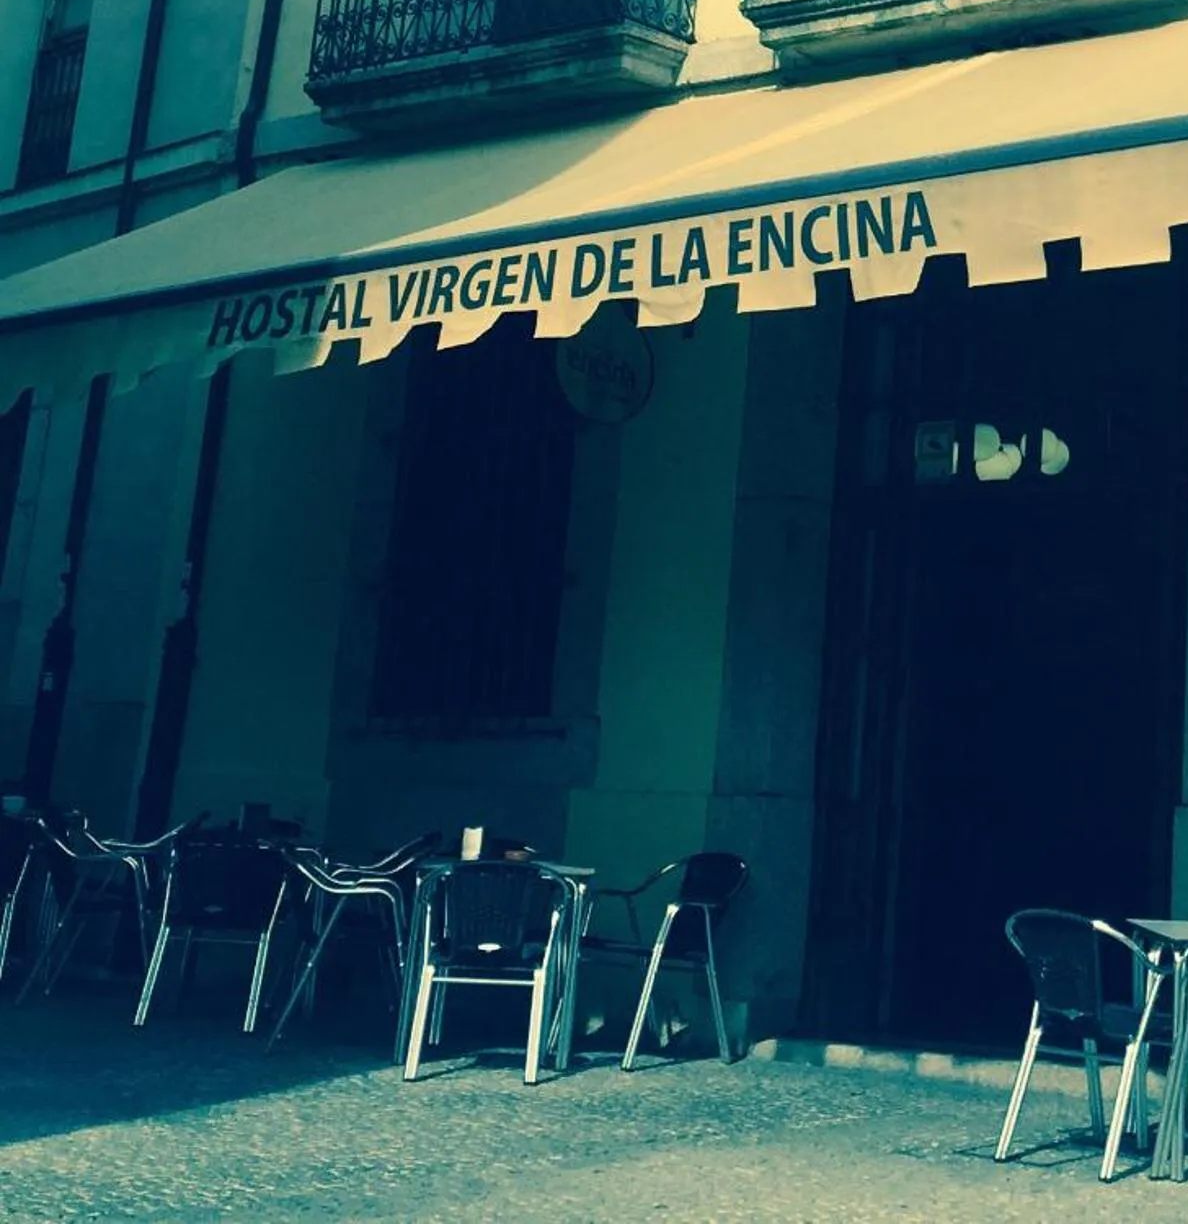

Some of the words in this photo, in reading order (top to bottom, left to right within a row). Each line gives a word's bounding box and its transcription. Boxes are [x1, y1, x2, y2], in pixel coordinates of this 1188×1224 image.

[207, 279, 373, 347] HOSTAL
[388, 249, 557, 322] VIRGEN
[571, 238, 636, 298] DE
[651, 226, 710, 288] LA
[728, 191, 937, 275] ENCINA
